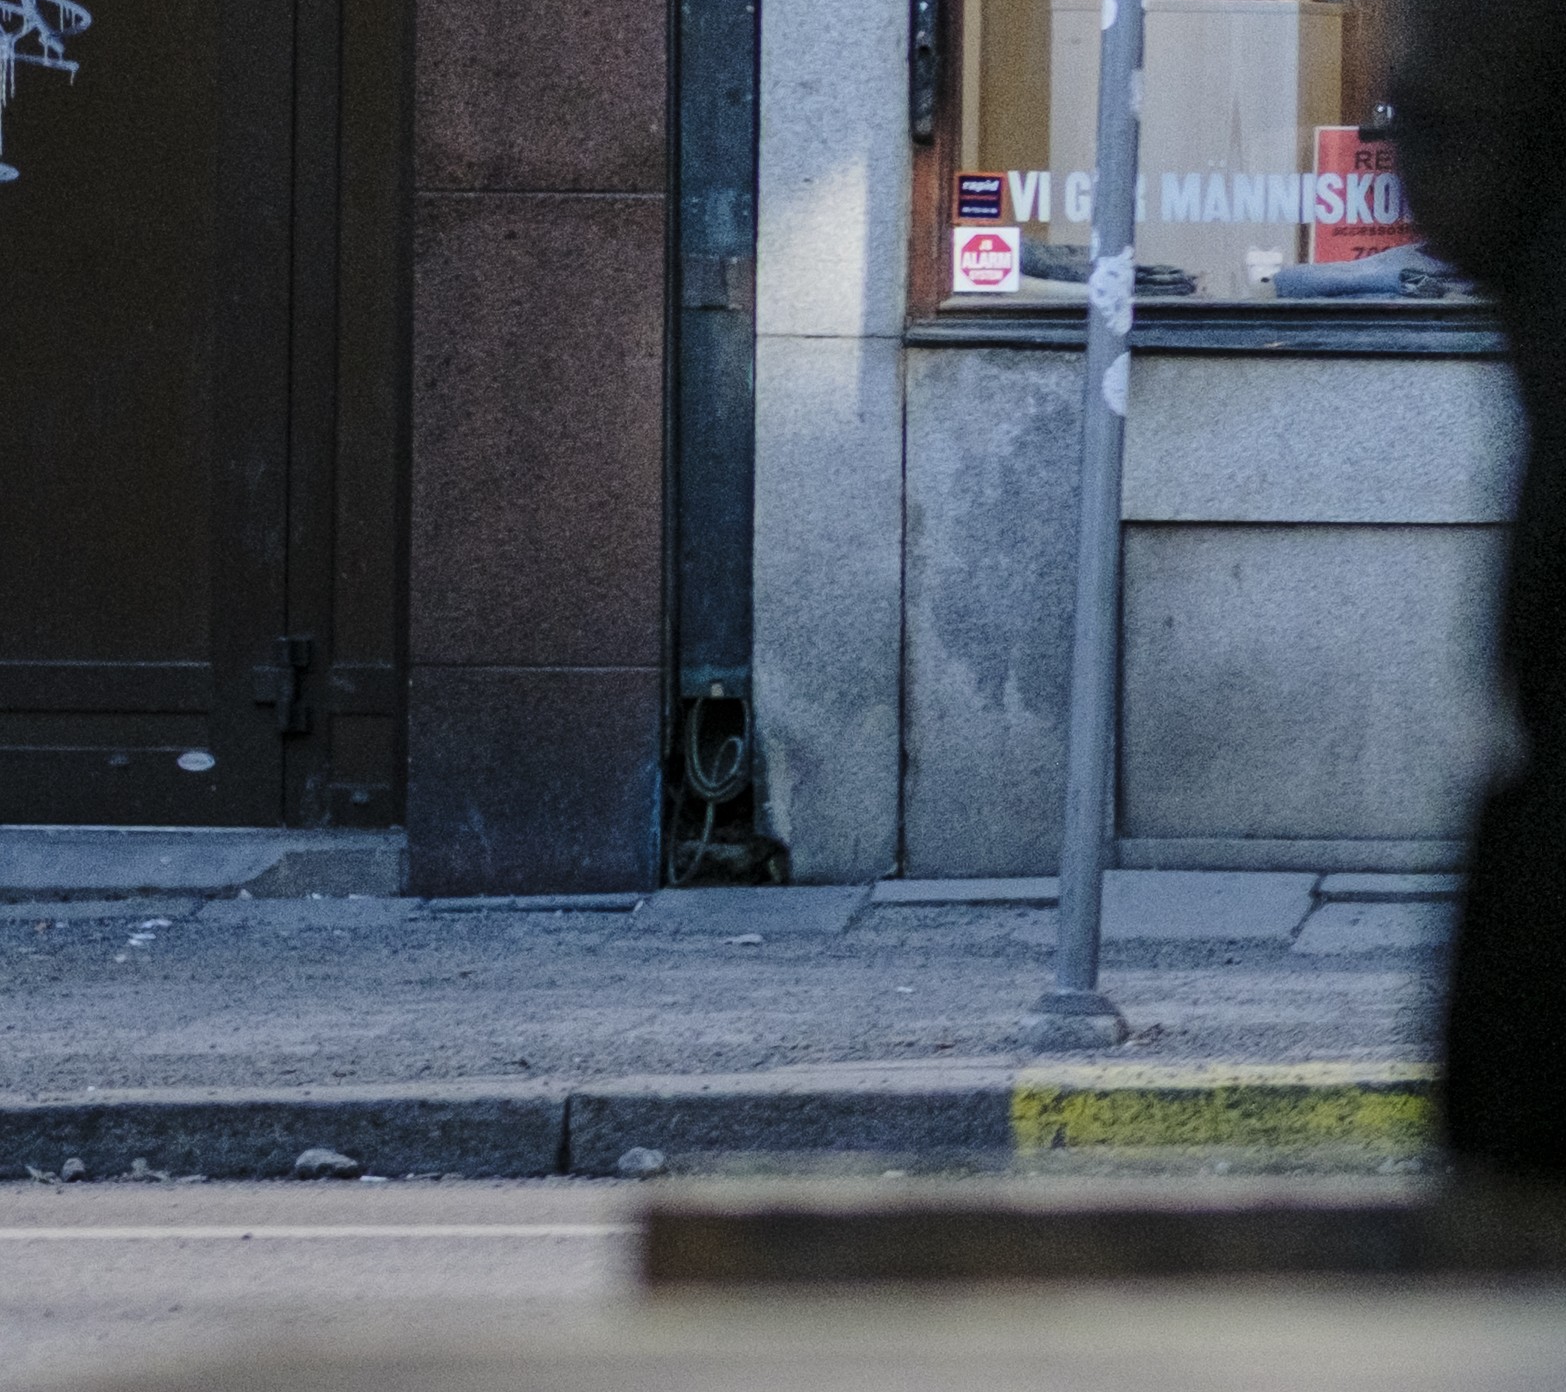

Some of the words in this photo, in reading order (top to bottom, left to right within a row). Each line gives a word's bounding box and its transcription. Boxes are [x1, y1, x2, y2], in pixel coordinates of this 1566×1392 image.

[1354, 150, 1393, 170] RE
[1007, 170, 1050, 222] VI
[962, 251, 1012, 269] ALARM
